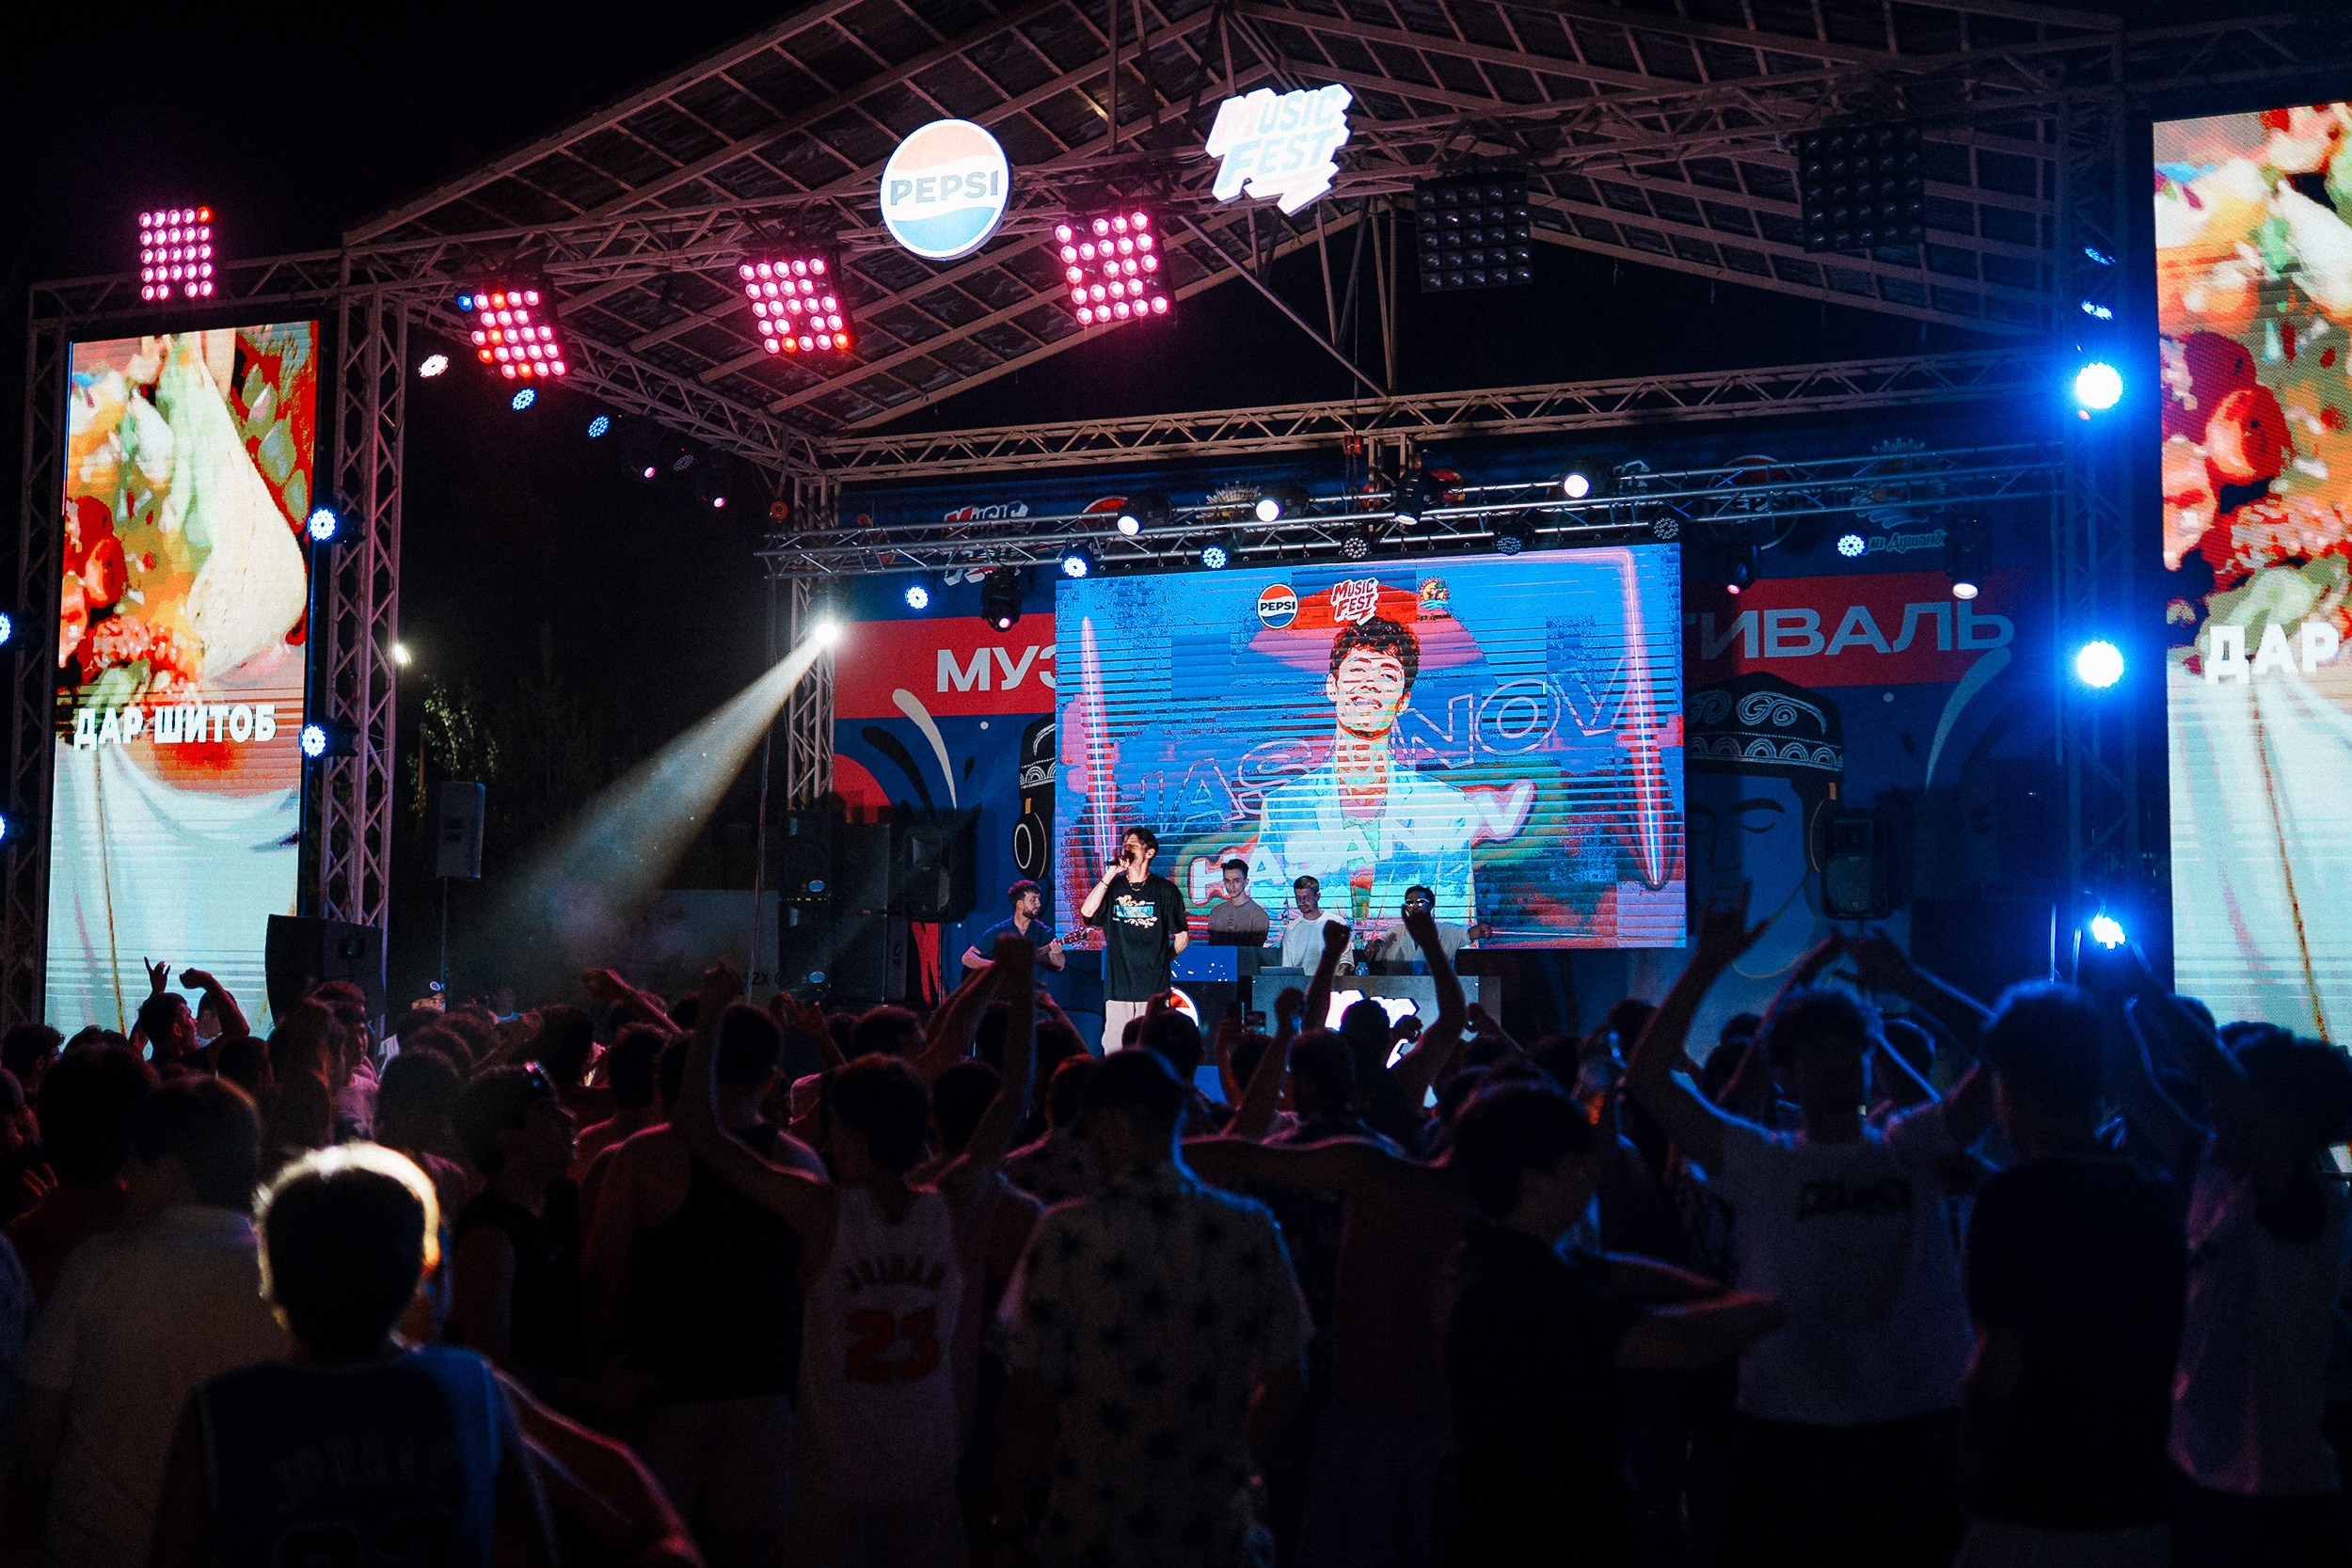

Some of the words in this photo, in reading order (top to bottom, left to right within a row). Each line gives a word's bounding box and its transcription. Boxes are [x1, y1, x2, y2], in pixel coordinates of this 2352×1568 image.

[1212, 88, 1341, 143] MUSIC
[1218, 128, 1338, 190] FEST
[890, 170, 999, 206] PEPSI
[1260, 600, 1296, 611] PEPSI
[1332, 578, 1375, 602] MUSIC
[1336, 594, 1375, 618] FEST
[1683, 601, 2015, 659] ИВАЛЬ
[2204, 621, 2340, 685] ДАР
[73, 706, 144, 751] ДАР
[154, 704, 277, 744] ШИТОБ
[847, 1308, 939, 1383] 23
